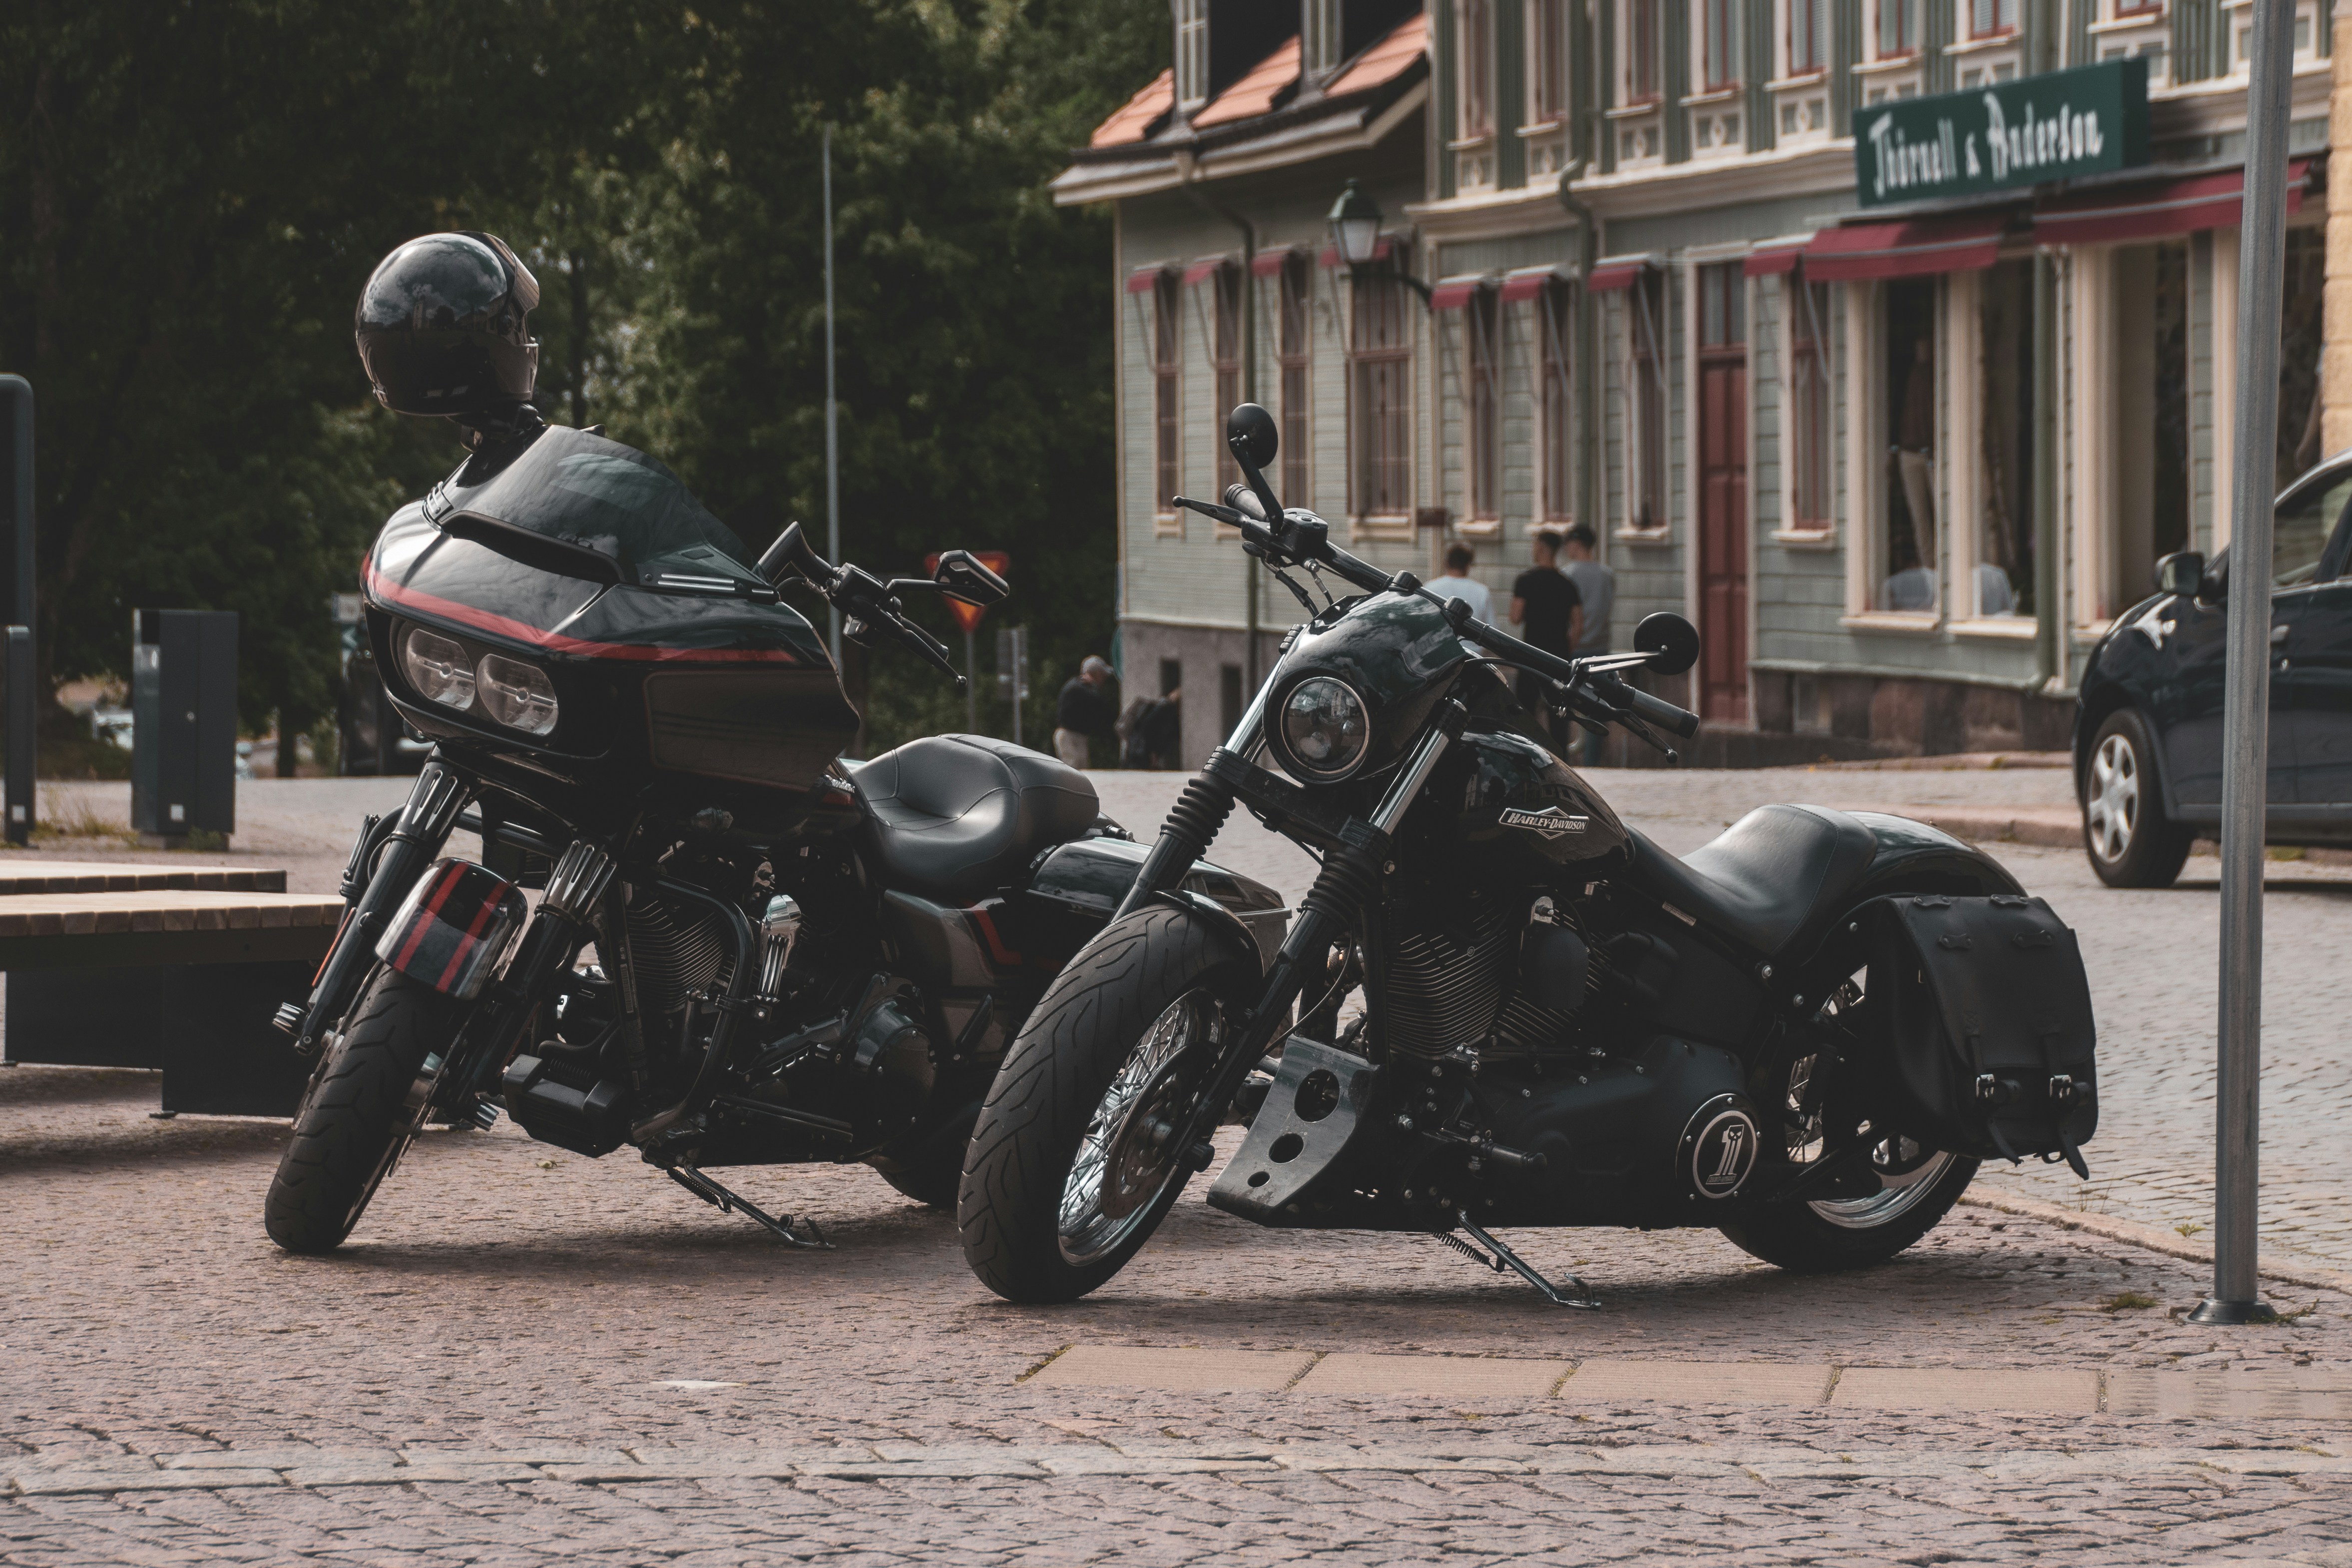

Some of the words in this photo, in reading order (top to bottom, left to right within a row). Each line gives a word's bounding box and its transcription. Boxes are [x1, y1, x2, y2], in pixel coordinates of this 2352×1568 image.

[1965, 132, 1980, 178] &
[1983, 92, 2103, 180] Anderson
[1507, 812, 1586, 830] HARLEY-DAVIDSON
